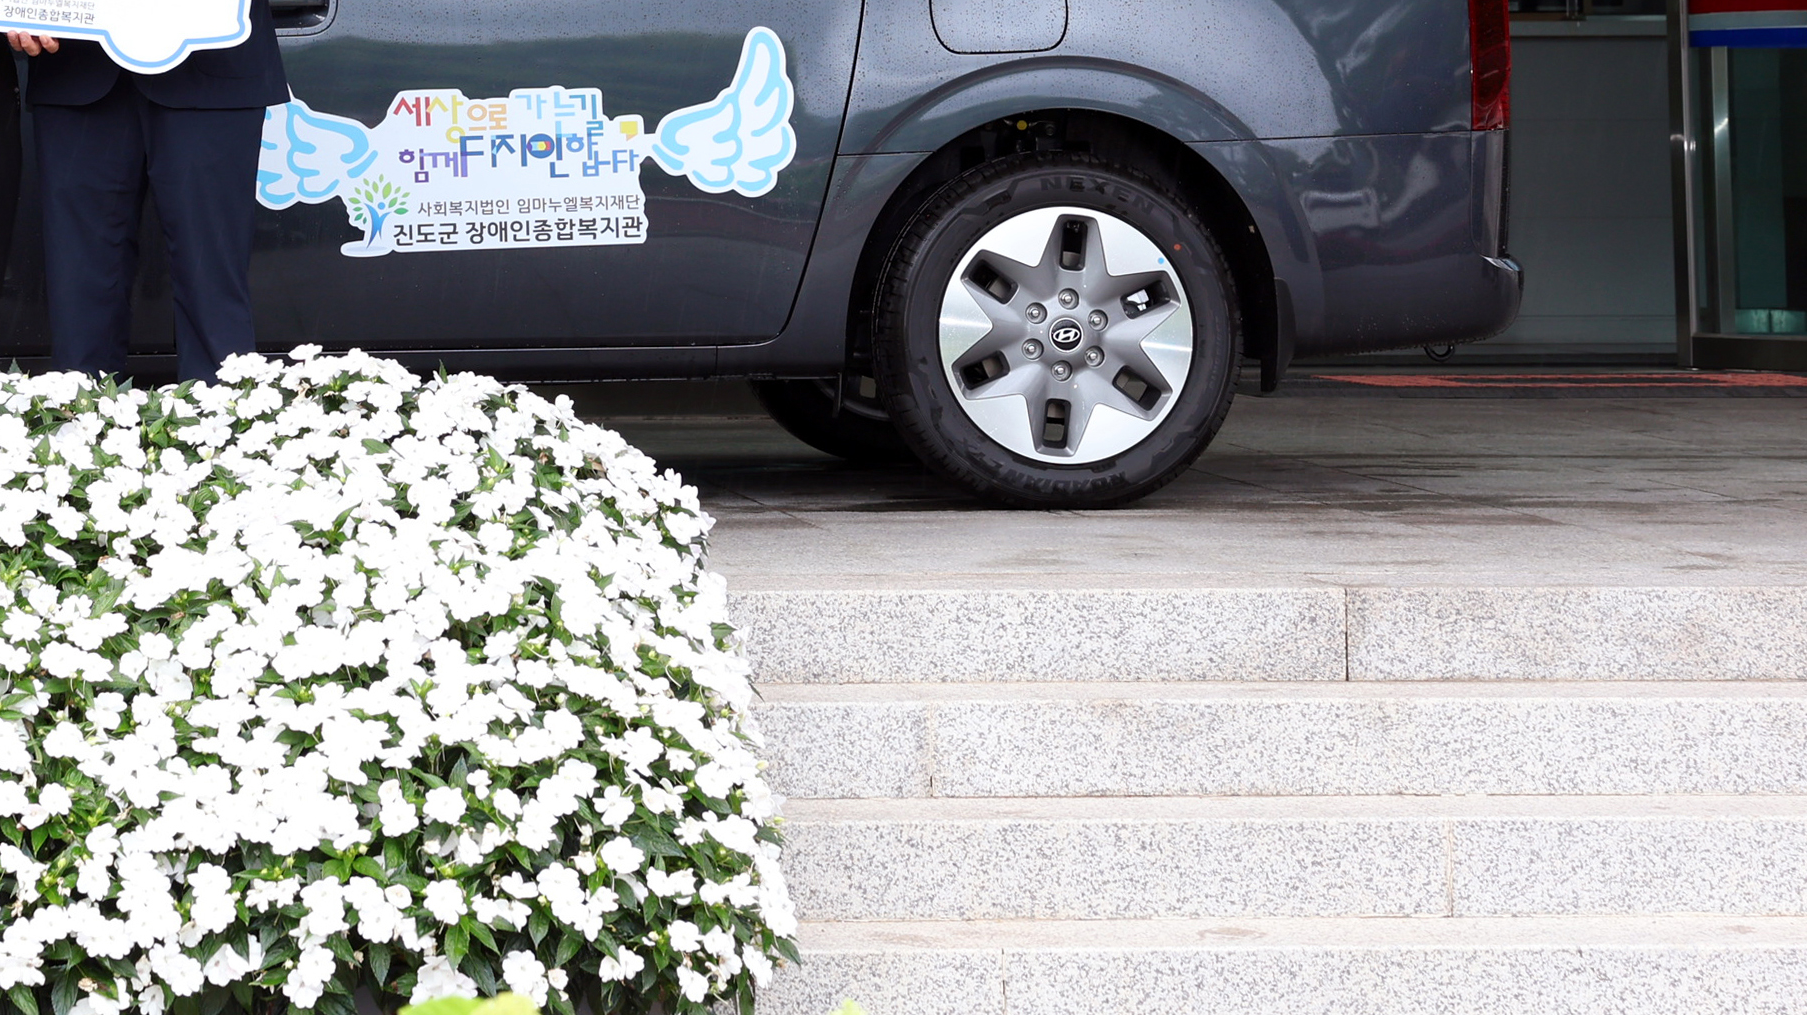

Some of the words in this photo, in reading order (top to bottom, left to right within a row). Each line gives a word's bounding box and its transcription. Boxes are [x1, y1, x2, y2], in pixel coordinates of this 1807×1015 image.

[3, 4, 96, 26] 장애인종합복지관
[393, 94, 509, 144] 세상으로
[417, 198, 511, 217] 사회복지법인
[516, 193, 641, 216] 임마누엘복지재단
[1039, 175, 1155, 215] NEXEN
[392, 221, 460, 247] 진도군
[464, 215, 643, 246] 장애인종합복지관
